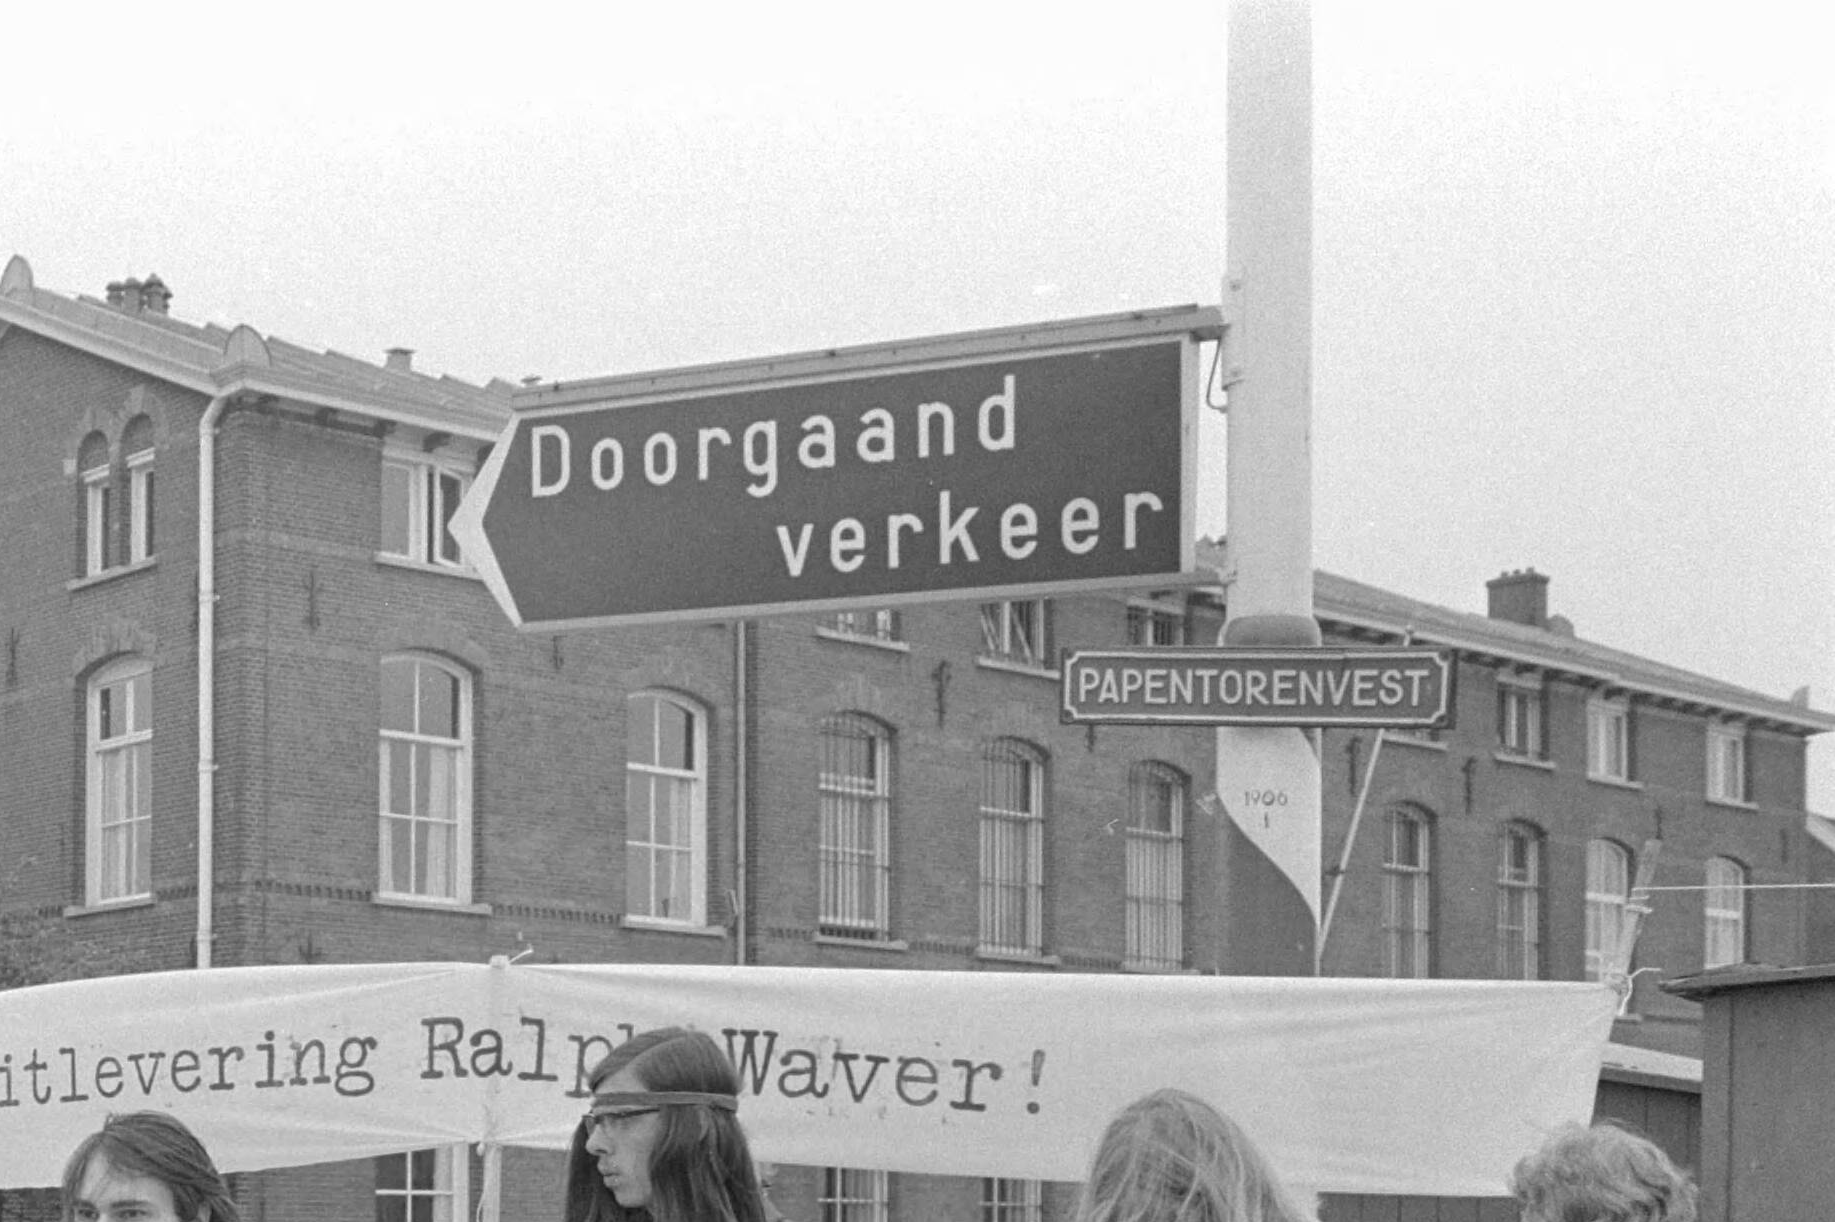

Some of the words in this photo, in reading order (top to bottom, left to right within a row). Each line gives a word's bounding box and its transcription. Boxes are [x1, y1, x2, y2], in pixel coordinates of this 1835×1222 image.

[531, 373, 1017, 499] Doorgaand
[776, 490, 1164, 578] verkeer
[1078, 667, 1430, 708] PAPENTORENVEST
[419, 1015, 636, 1100] Ralp
[720, 1025, 1048, 1116] Waver!
